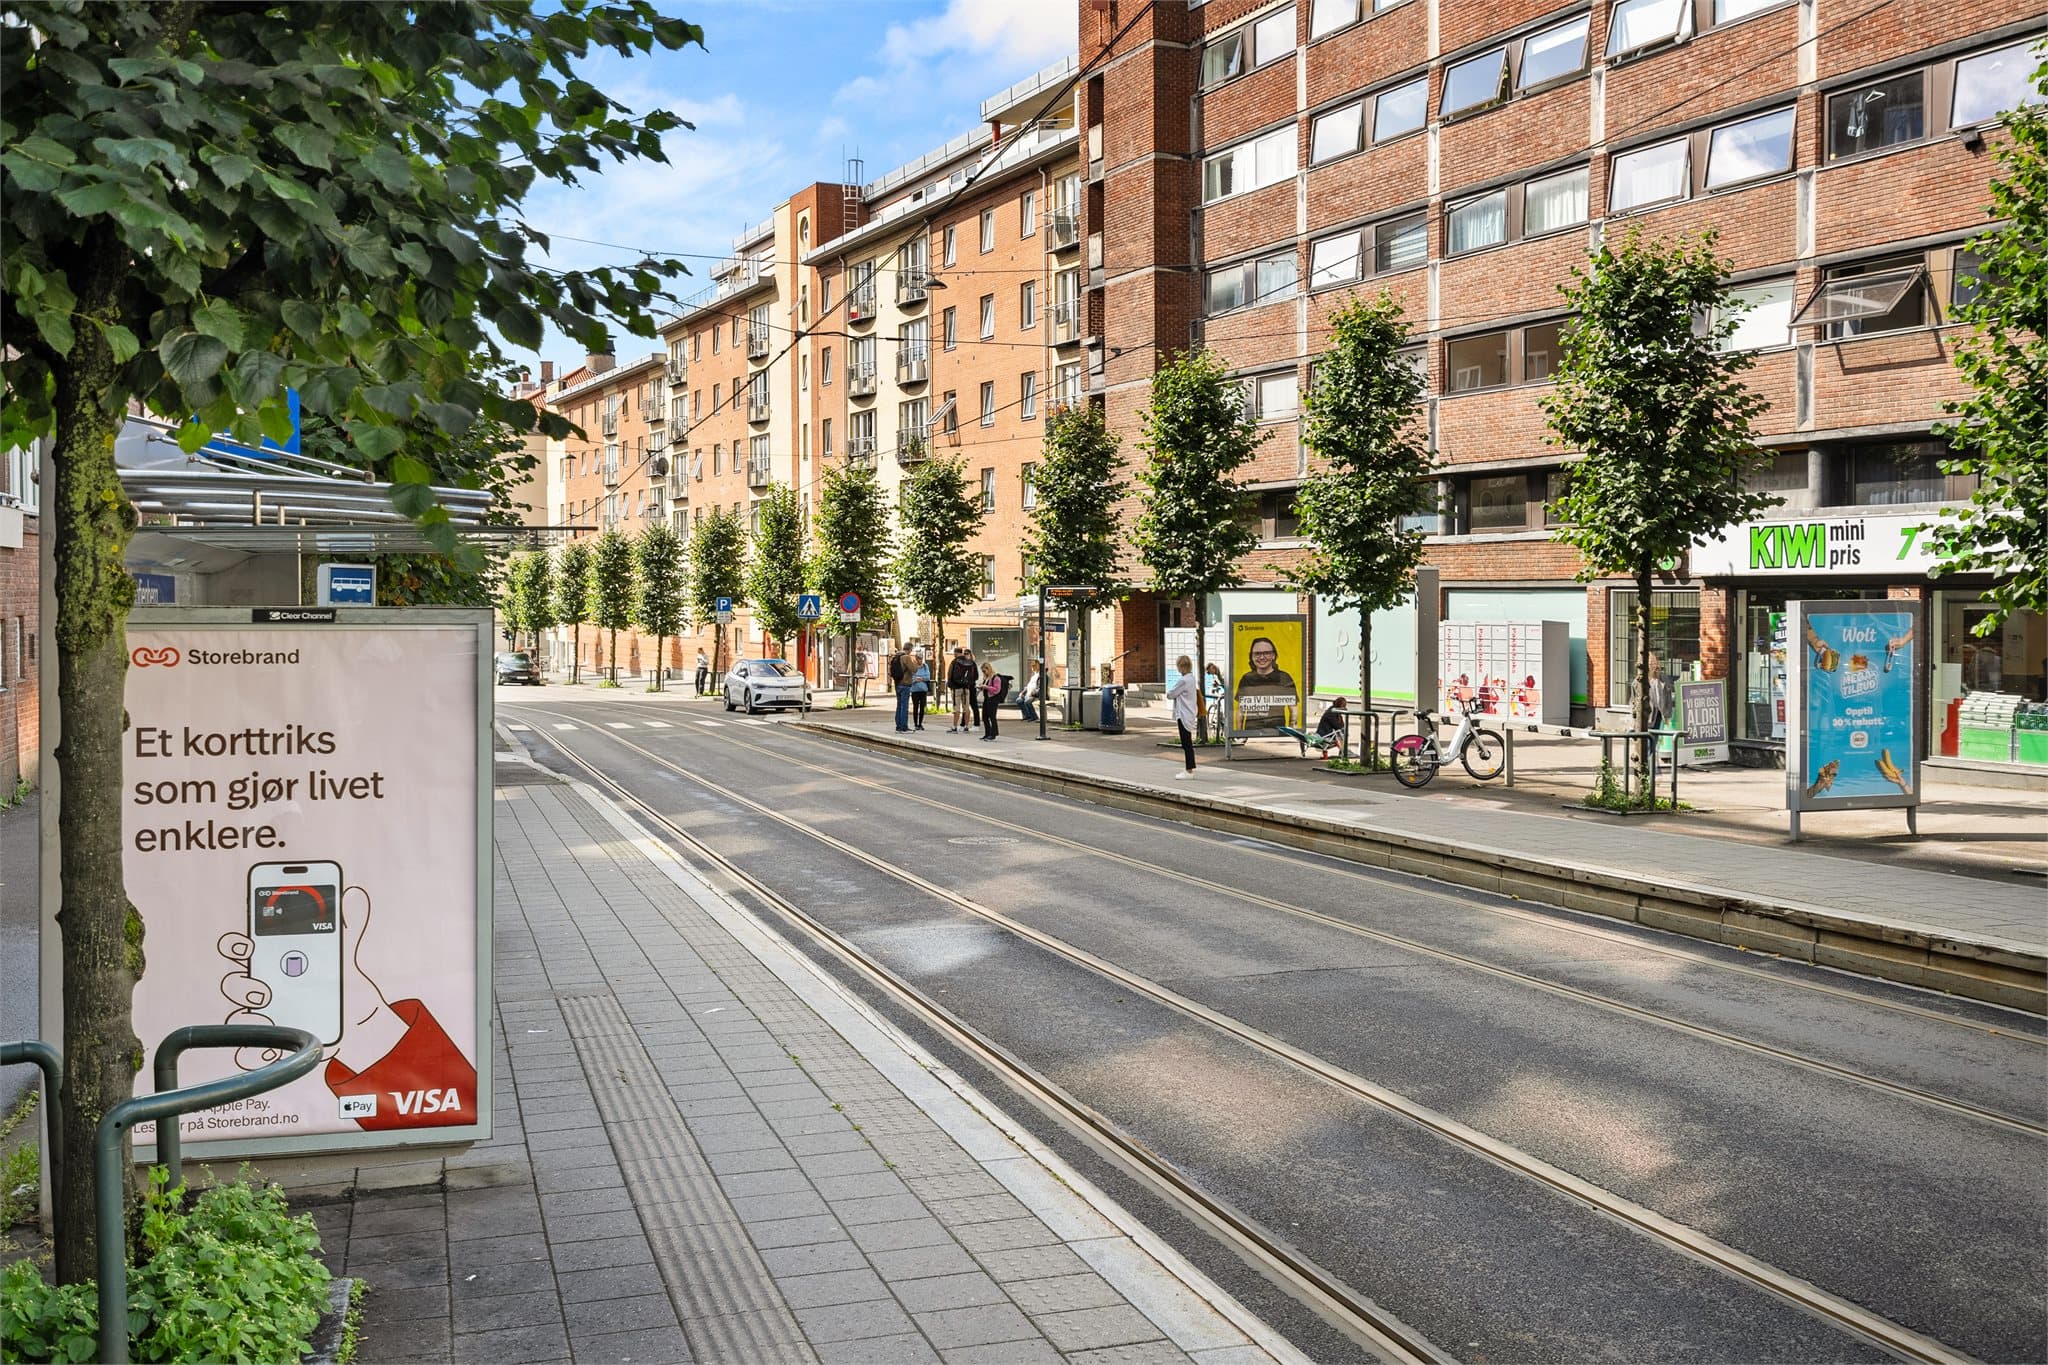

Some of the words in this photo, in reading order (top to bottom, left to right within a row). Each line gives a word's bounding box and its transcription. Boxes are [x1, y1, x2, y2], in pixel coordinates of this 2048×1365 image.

[1750, 523, 1826, 569] KIWI
[1829, 519, 1865, 542] mini
[1829, 544, 1861, 569] pris
[720, 599, 728, 610] P
[280, 612, 300, 620] Clear
[301, 612, 333, 620] Channel
[1842, 627, 1877, 642] Wolt
[188, 649, 300, 665] Storebrand
[1842, 679, 1876, 696] TILBUD
[1239, 695, 1252, 703] Fra
[1254, 695, 1261, 703] IV
[1687, 697, 1694, 708] VI
[1706, 696, 1720, 707] OSS
[1687, 707, 1720, 726] ALDRI
[1846, 706, 1873, 717] Opptil
[1700, 725, 1721, 738] PRIS!
[136, 727, 173, 757] Et
[184, 723, 337, 757] korttriks
[133, 779, 217, 805] som
[226, 771, 299, 811] gjør
[309, 769, 385, 801] livet
[134, 819, 287, 851] enklere.
[312, 922, 333, 931] VISA
[246, 1098, 271, 1112] Pay.
[352, 1101, 373, 1113] Pay
[387, 1087, 462, 1115] VISA
[134, 1123, 156, 1134] Les
[187, 1117, 205, 1133] på
[207, 1113, 299, 1130] Storebrand.no
